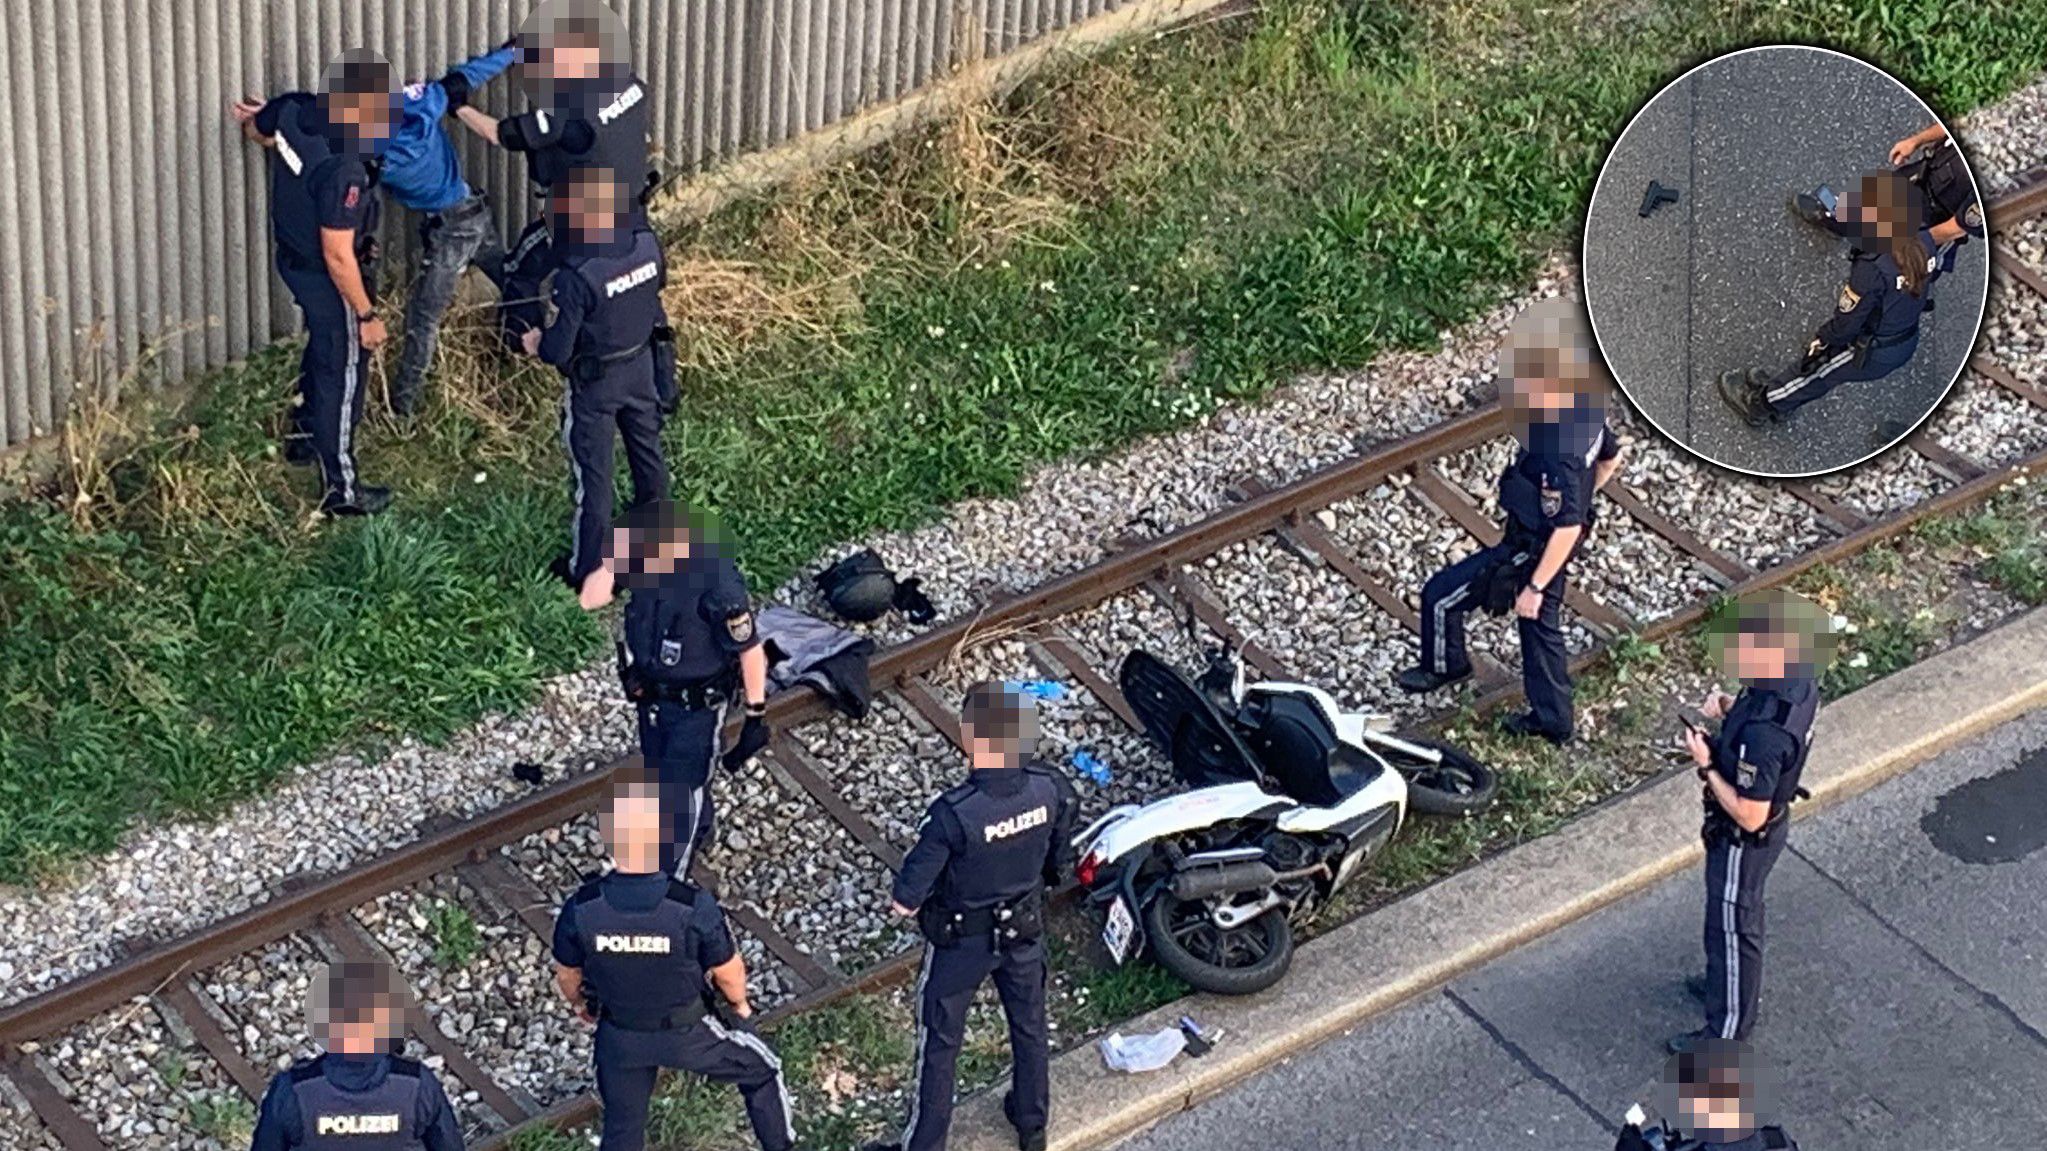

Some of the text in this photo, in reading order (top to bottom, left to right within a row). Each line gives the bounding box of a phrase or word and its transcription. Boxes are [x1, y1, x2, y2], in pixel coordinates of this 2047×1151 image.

[597, 83, 644, 125] POLIZEI
[605, 261, 658, 298] POLIZEI
[984, 805, 1047, 842] POLIZEI
[596, 935, 671, 953] POLIZEI
[318, 1114, 399, 1135] POLIZEI
